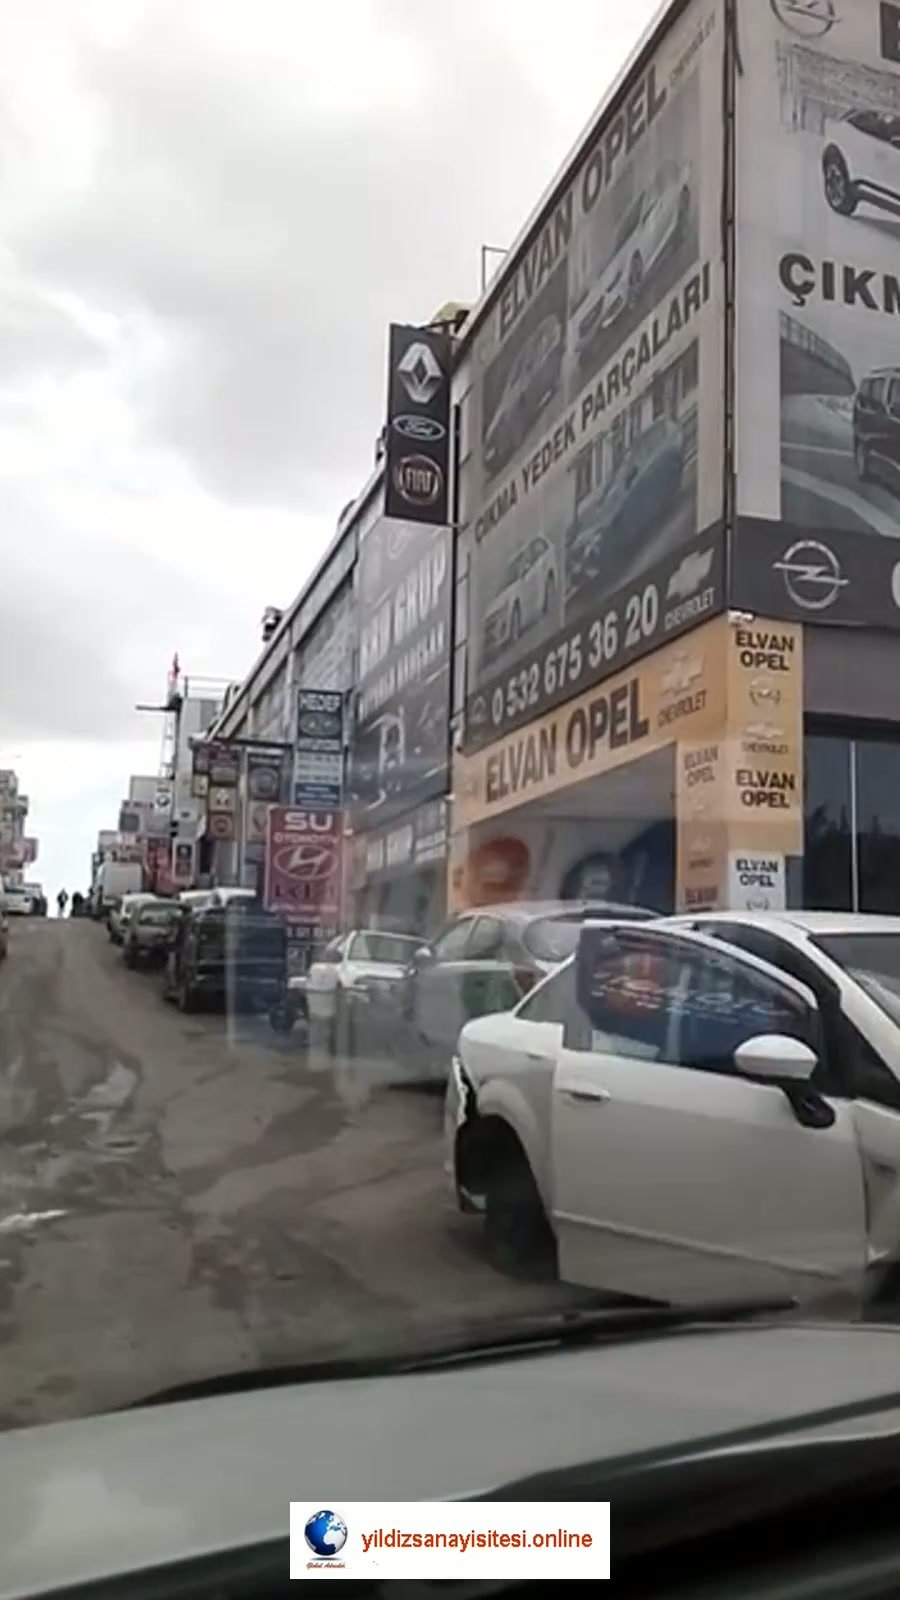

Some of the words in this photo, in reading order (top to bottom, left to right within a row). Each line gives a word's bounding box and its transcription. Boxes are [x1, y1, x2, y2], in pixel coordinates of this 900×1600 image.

[500, 190, 574, 339] ELVAN
[583, 65, 667, 213] OPEL
[521, 412, 577, 492] YEDEK
[581, 262, 711, 433] PARÇALARI
[735, 630, 795, 652] ELVAN
[492, 687, 503, 726] 0
[507, 663, 540, 717] 532
[544, 633, 581, 694] 675
[588, 610, 619, 659] 36
[624, 584, 659, 647] 20
[740, 650, 790, 671] OPEL
[486, 723, 557, 804] ELVAN
[565, 677, 650, 768] OPEL
[736, 768, 795, 791] ELVAN
[741, 790, 790, 809] OPEL
[284, 811, 333, 832] SU
[736, 859, 778, 873] ELVAN
[739, 874, 775, 887] OPEL
